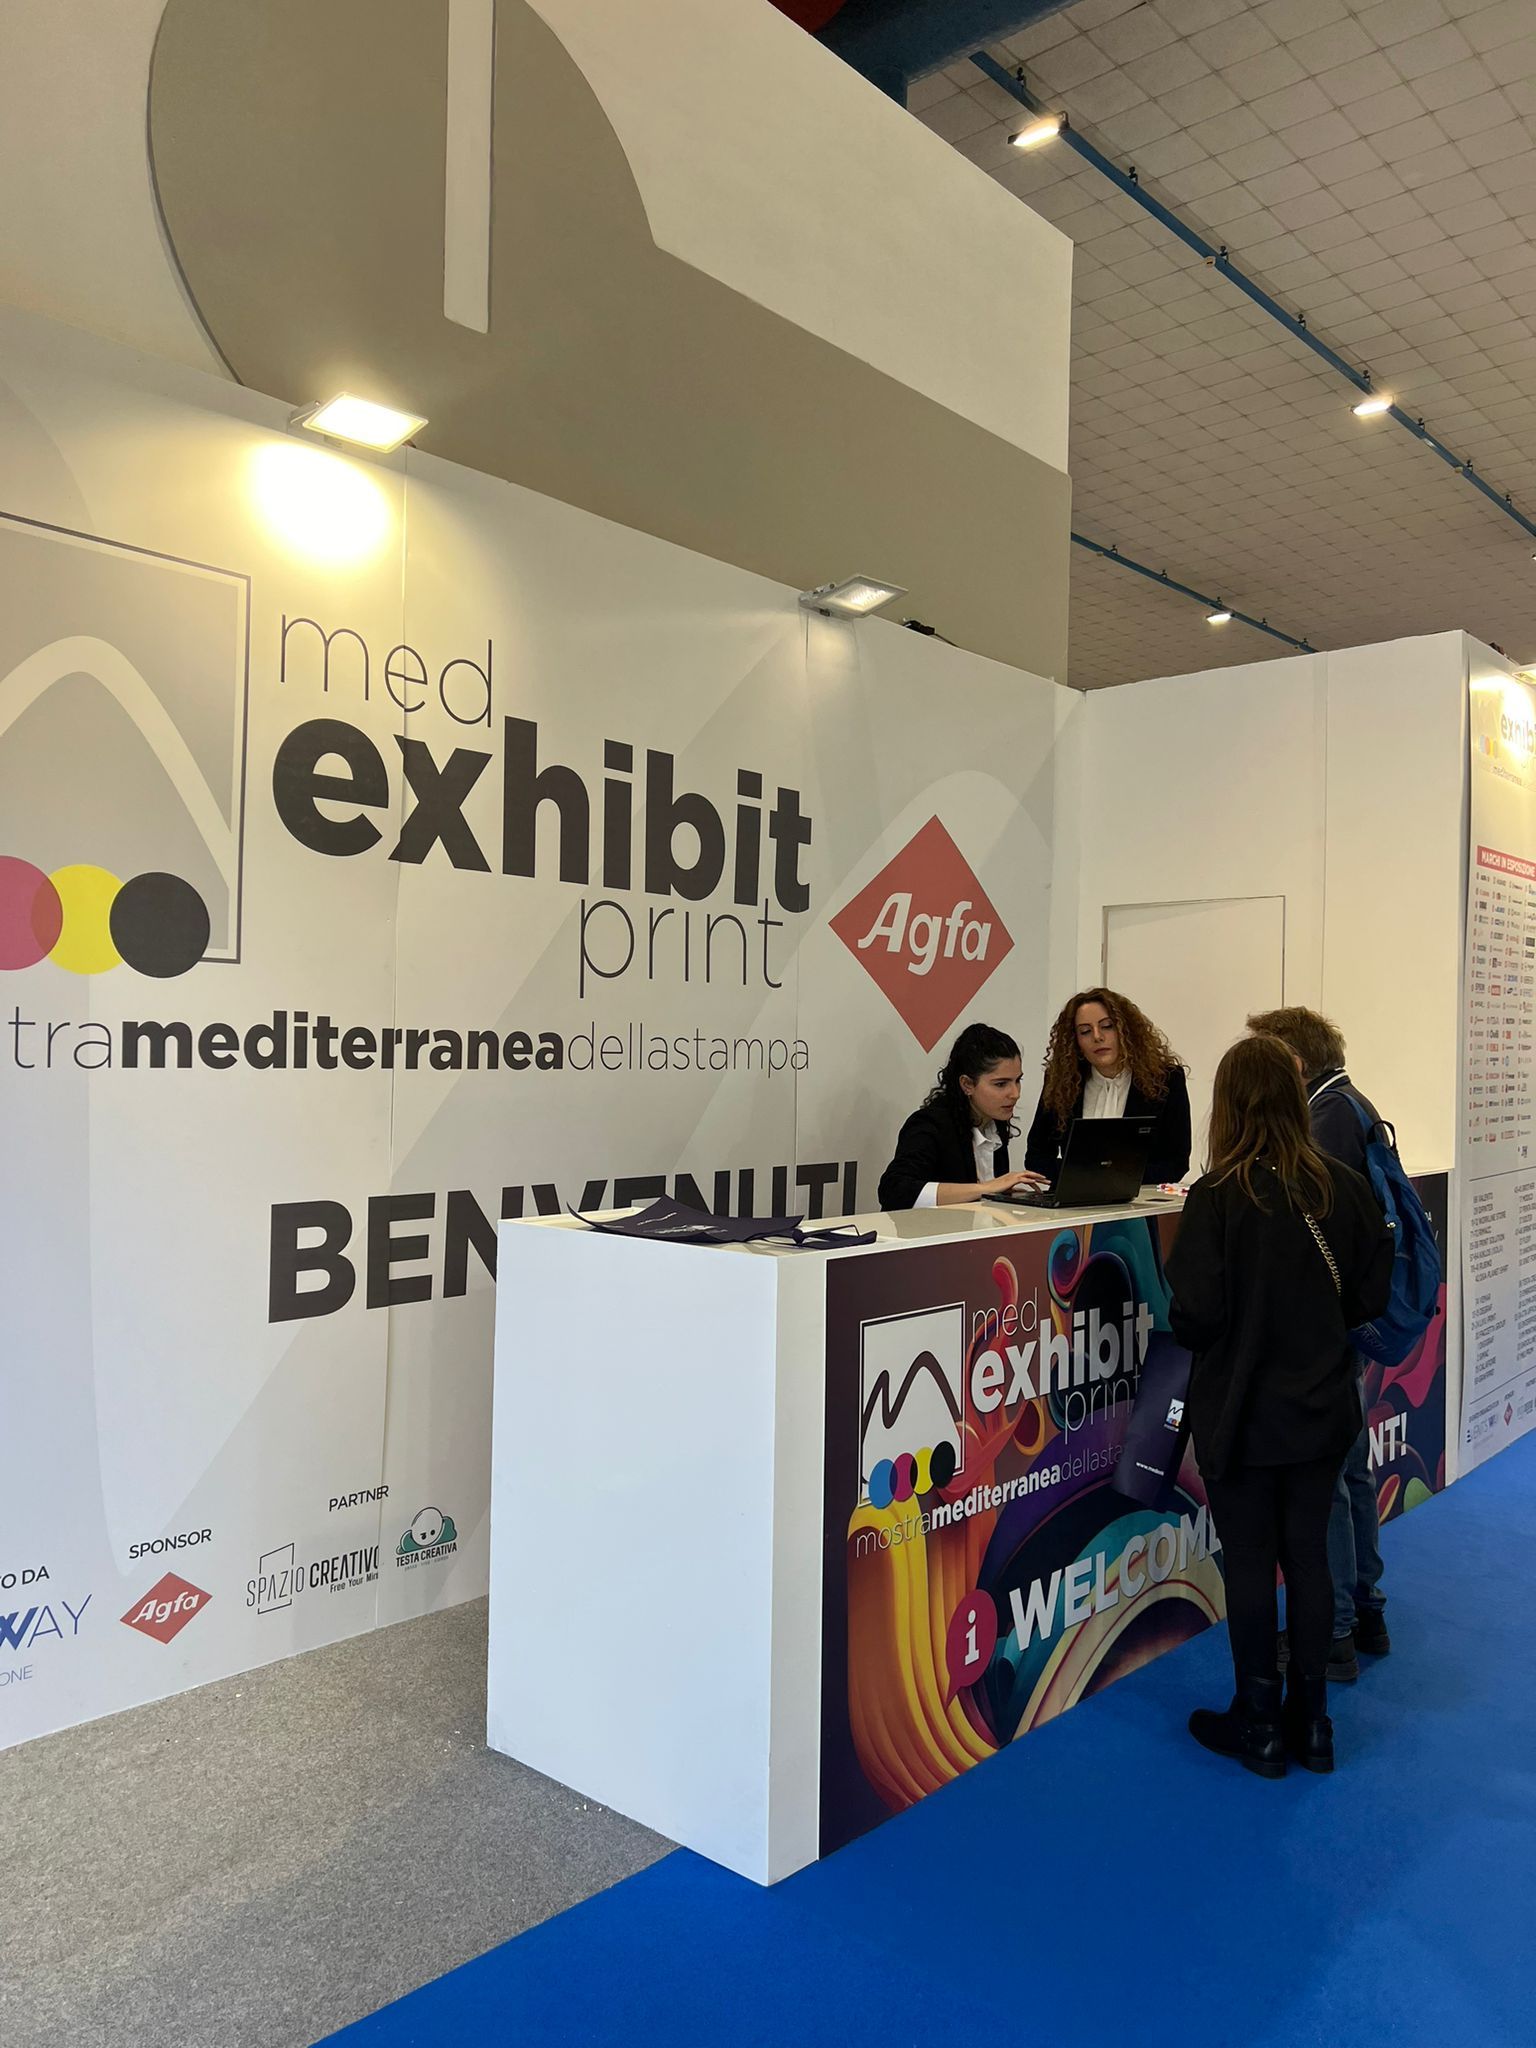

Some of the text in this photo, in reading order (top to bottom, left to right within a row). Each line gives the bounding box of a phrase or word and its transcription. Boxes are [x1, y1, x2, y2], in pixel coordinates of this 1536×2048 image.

[281, 612, 493, 728] med
[272, 716, 812, 914] exhibit
[579, 898, 784, 998] print
[857, 892, 992, 976] Agfa
[972, 1287, 1039, 1341] med
[971, 1301, 1155, 1414] exhibit
[329, 1485, 389, 1512] PARTNER
[129, 1528, 212, 1560] SPONSOR
[396, 1554, 420, 1568] TESTA
[420, 1542, 458, 1561] CREATIVA
[0, 1565, 50, 1589] O DA
[247, 1566, 304, 1607] SPAZIO
[330, 1569, 379, 1594] Free Your Min
[132, 1593, 201, 1624] Agfa
